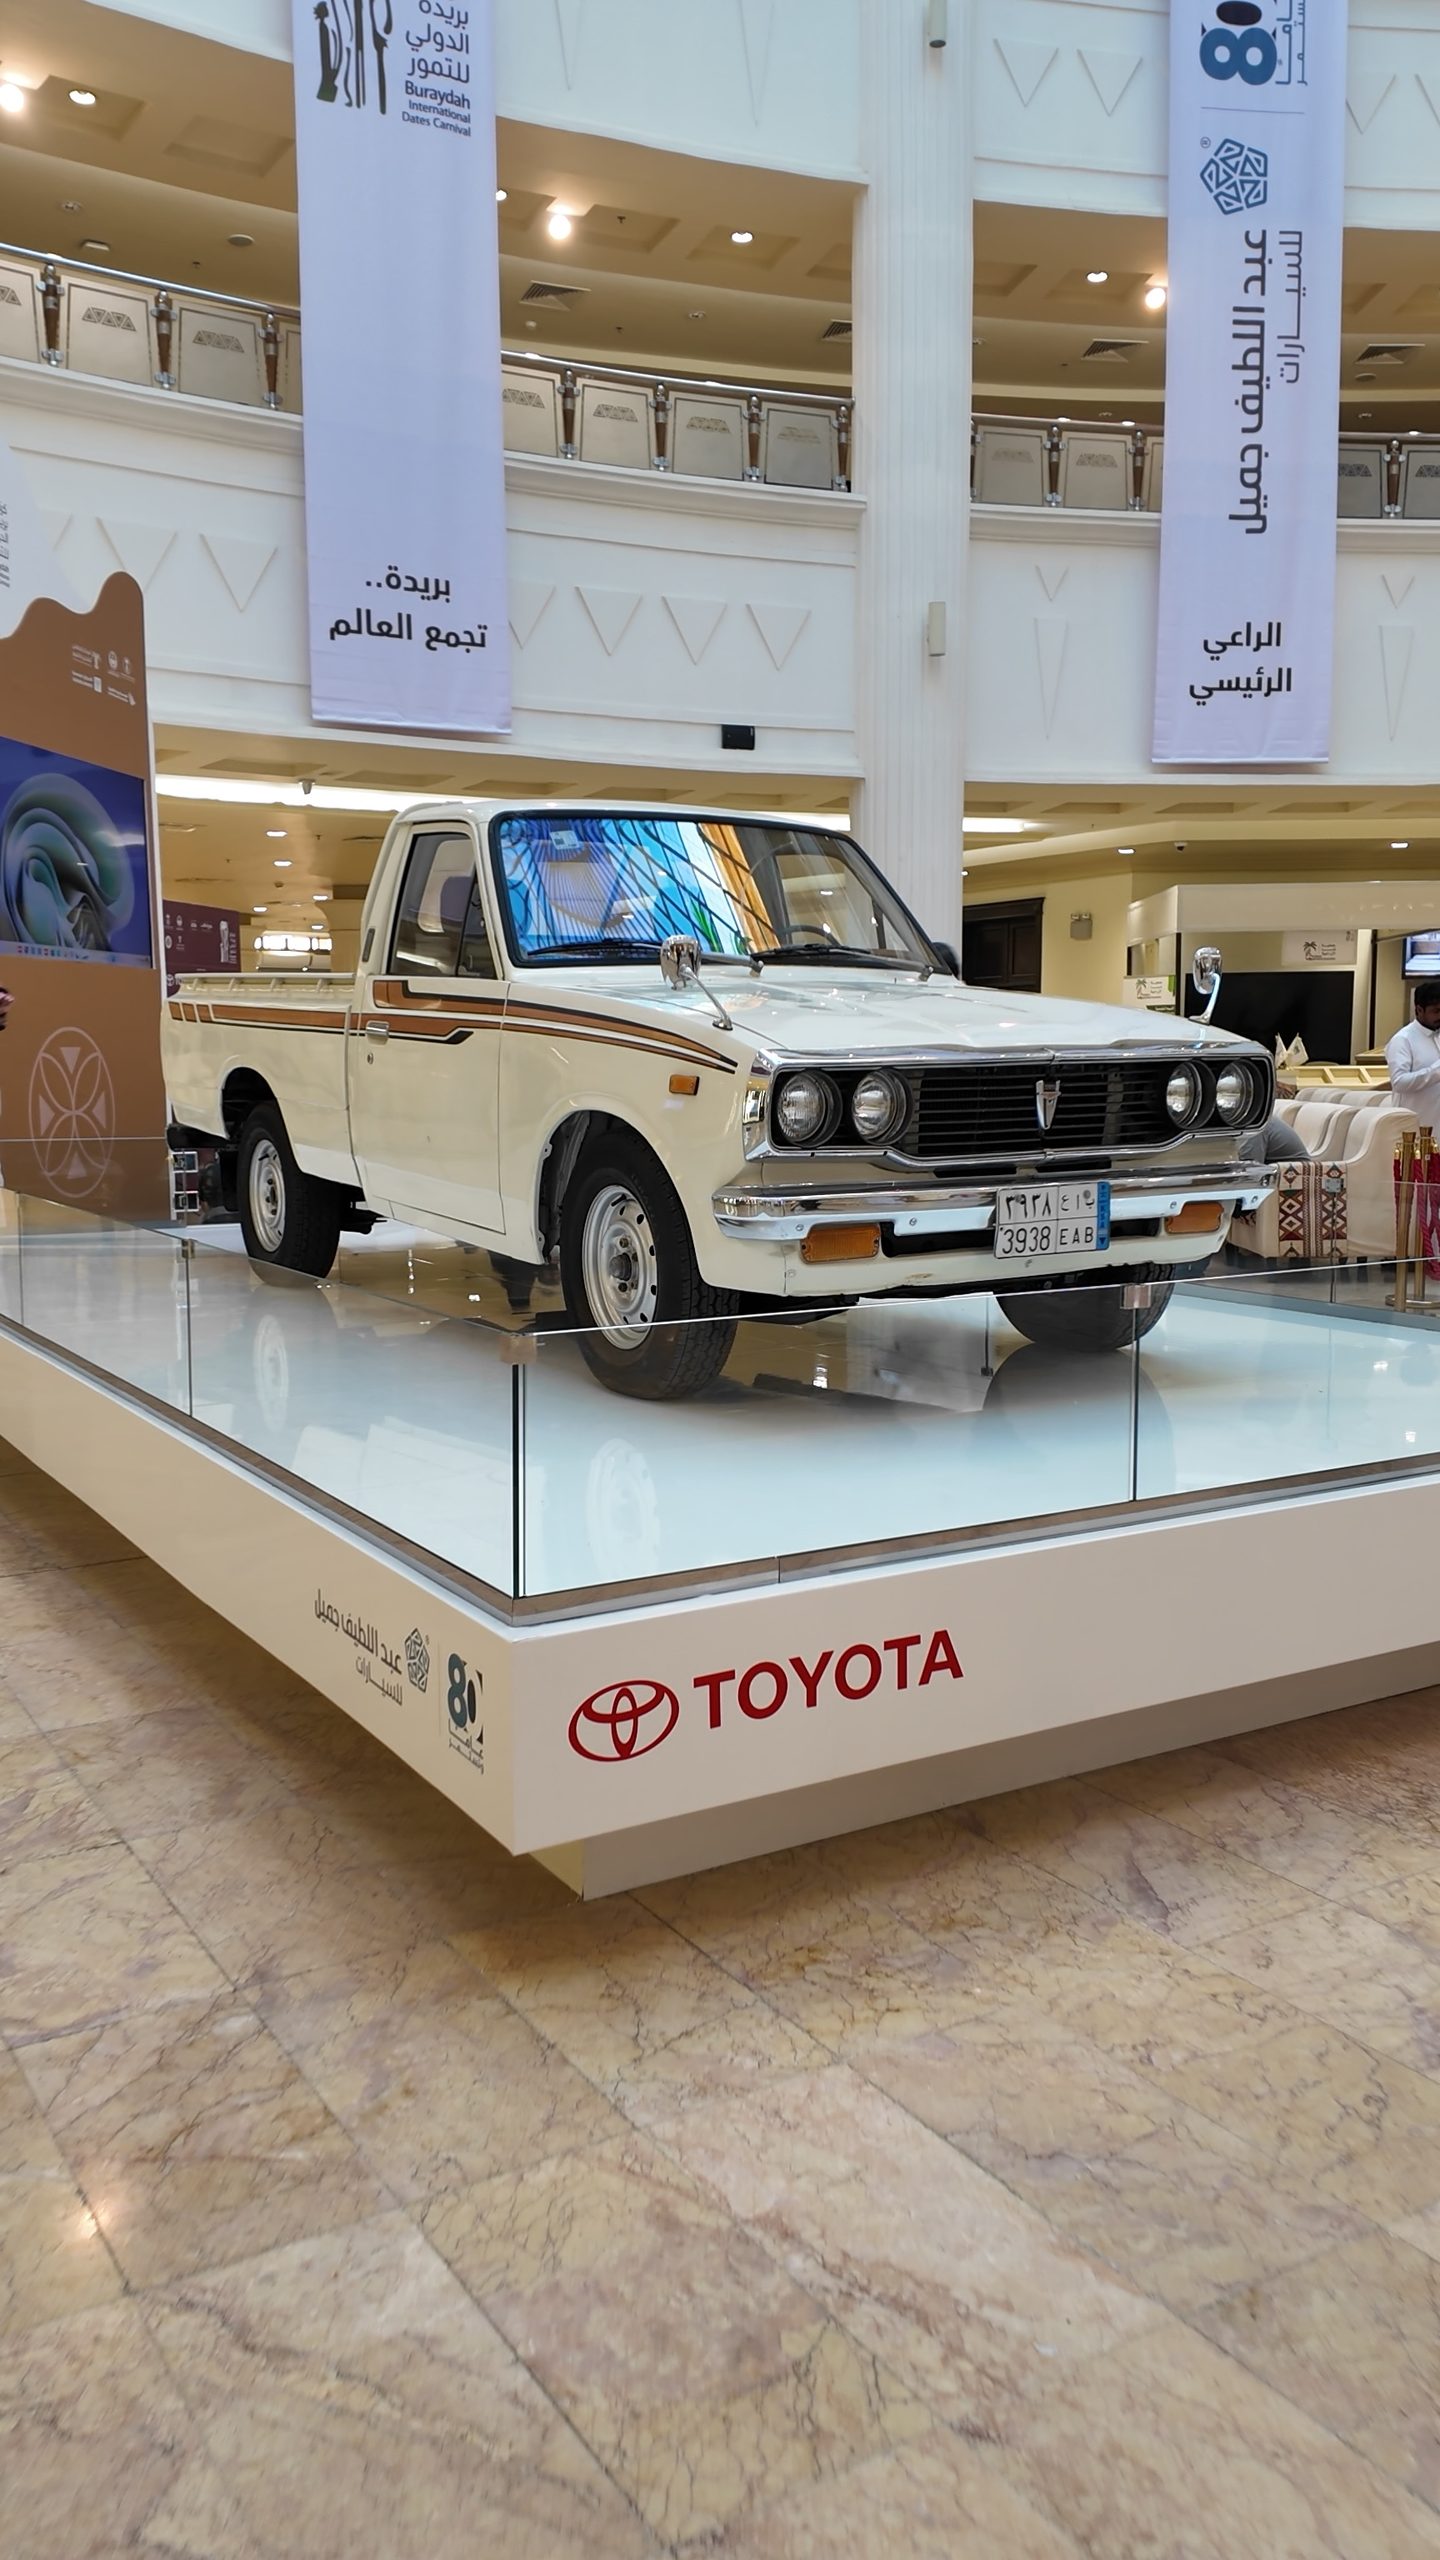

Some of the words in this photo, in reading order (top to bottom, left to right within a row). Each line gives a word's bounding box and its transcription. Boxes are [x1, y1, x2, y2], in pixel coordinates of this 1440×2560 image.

[405, 23, 470, 54] الدولي
[407, 57, 470, 84] للتمور
[404, 80, 471, 110] Buraydah
[408, 99, 471, 124] International
[401, 111, 431, 127] Dates
[433, 119, 471, 137] Carnival
[1243, 229, 1273, 296] عبد
[1231, 306, 1270, 434] اللطيف
[1228, 443, 1269, 535] جميل
[329, 607, 413, 641] العالم
[425, 624, 488, 654] تجمع
[1203, 621, 1282, 661] الراعي
[1189, 666, 1292, 706] الرئيسي
[1002, 1225, 1052, 1255] 3938
[1059, 1226, 1095, 1246] EAB
[314, 1588, 340, 1632] جميل
[341, 1612, 379, 1657] اللطيف
[380, 1642, 402, 1676] عبد
[692, 1628, 964, 1730] TOYOTA
